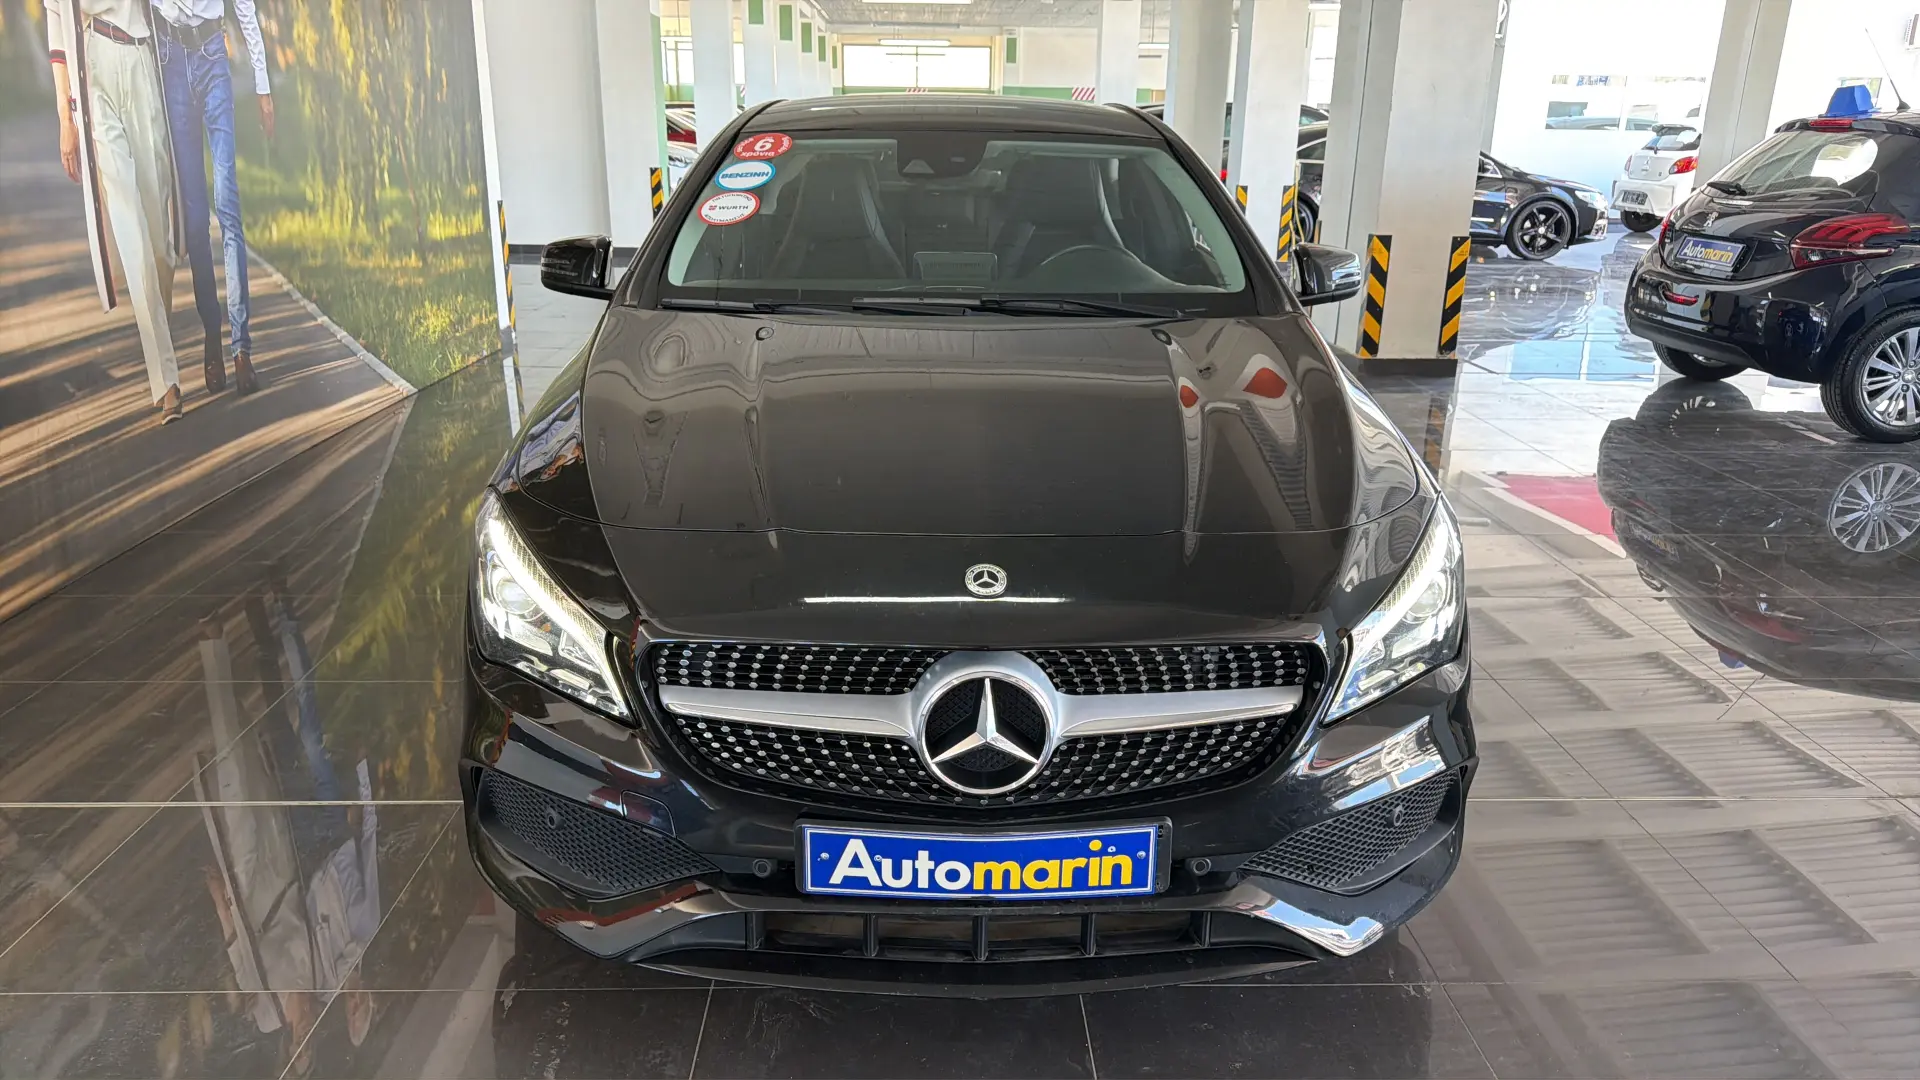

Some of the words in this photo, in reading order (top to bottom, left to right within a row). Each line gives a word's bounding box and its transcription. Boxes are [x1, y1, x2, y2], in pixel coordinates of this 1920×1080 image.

[754, 138, 775, 151] 6
[1681, 240, 1734, 262] Automarin
[828, 838, 1133, 891] Automarin
